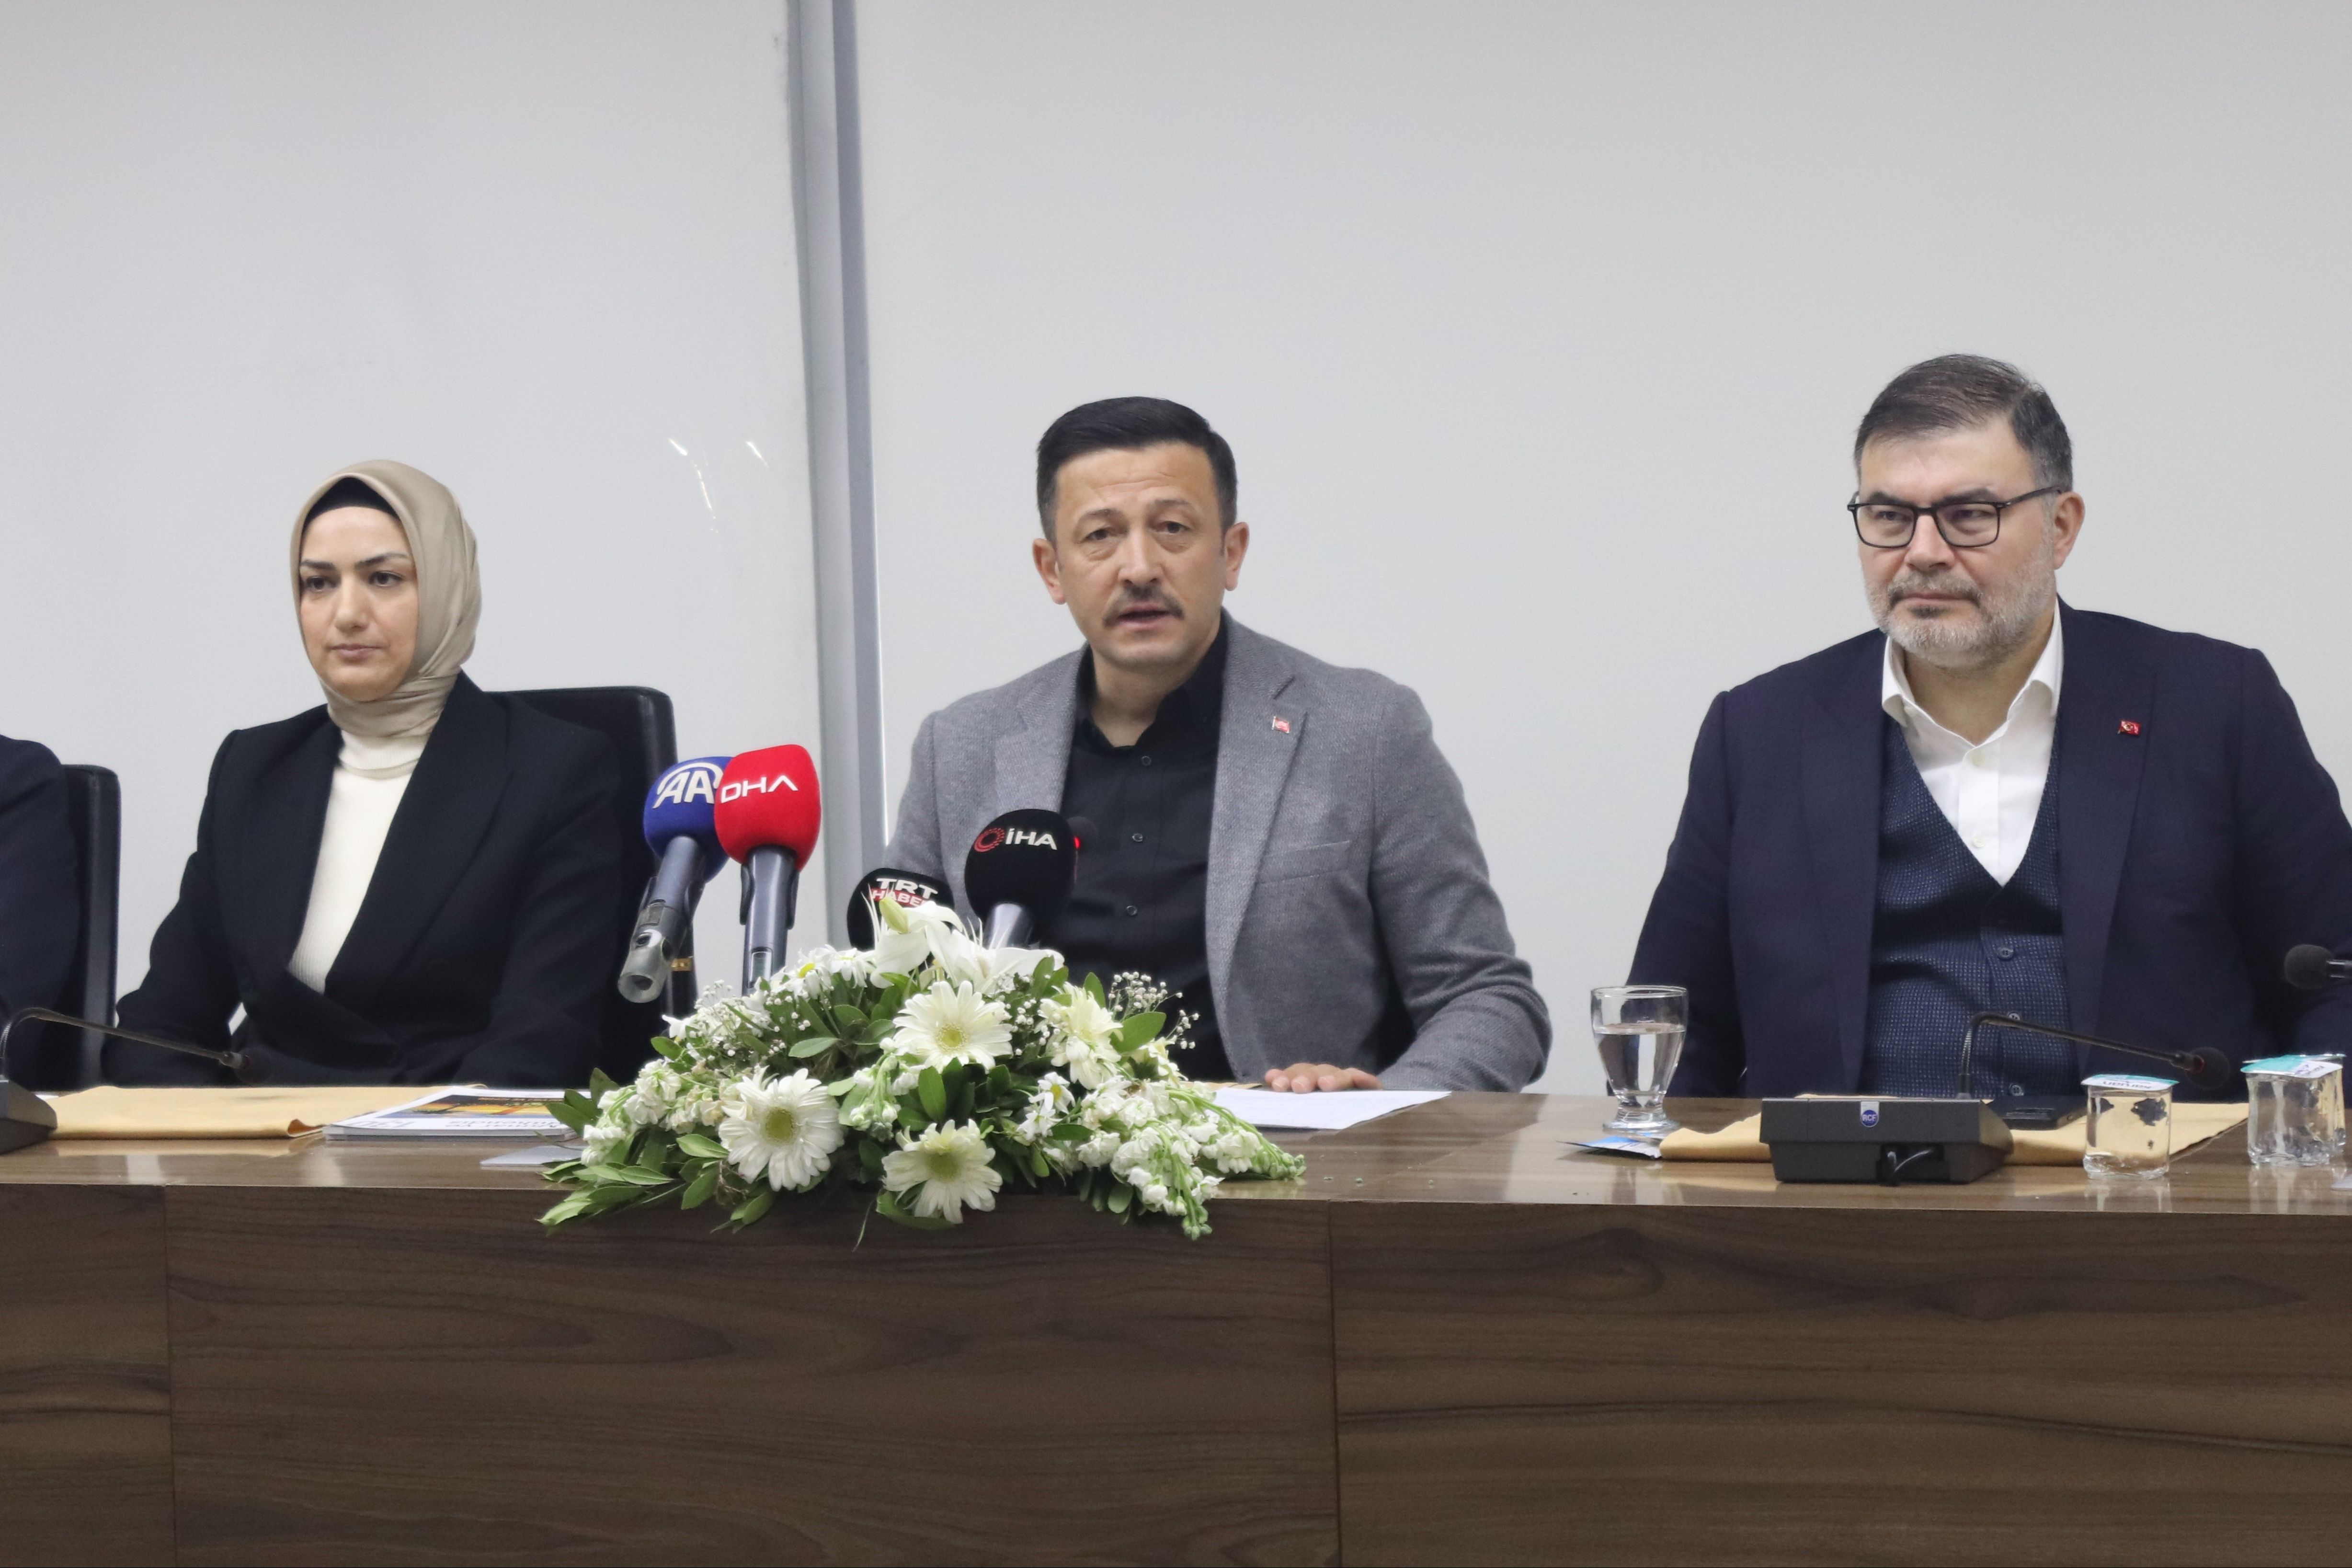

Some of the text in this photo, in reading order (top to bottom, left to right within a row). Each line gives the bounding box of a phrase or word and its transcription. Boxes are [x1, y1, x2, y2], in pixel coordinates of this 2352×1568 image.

[652, 770, 715, 809] AA
[872, 889, 928, 907] HABE
[876, 878, 938, 899] TRT
